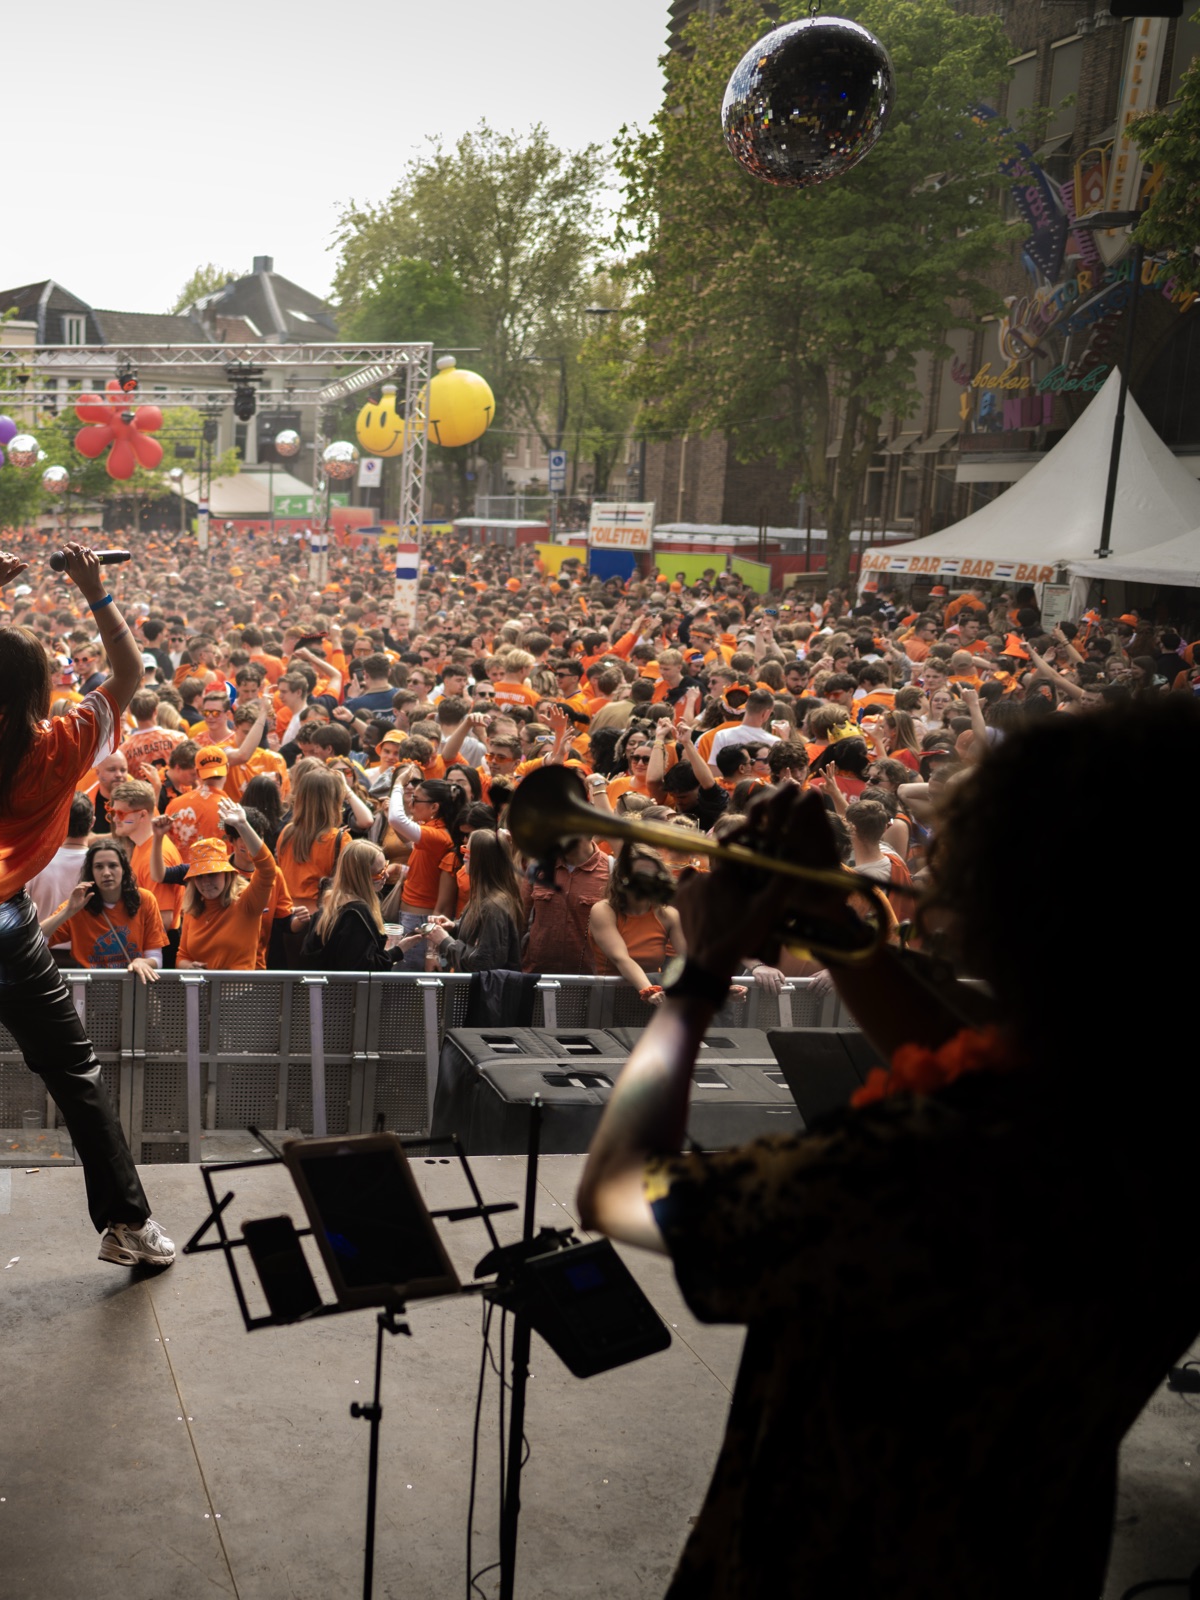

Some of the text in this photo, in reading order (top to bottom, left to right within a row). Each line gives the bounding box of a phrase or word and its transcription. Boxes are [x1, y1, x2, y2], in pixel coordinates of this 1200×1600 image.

[591, 526, 648, 545] TOILETTEN
[861, 554, 1055, 583] BAR BAR BAR BAR
[127, 740, 173, 759] VAN BASTEN
